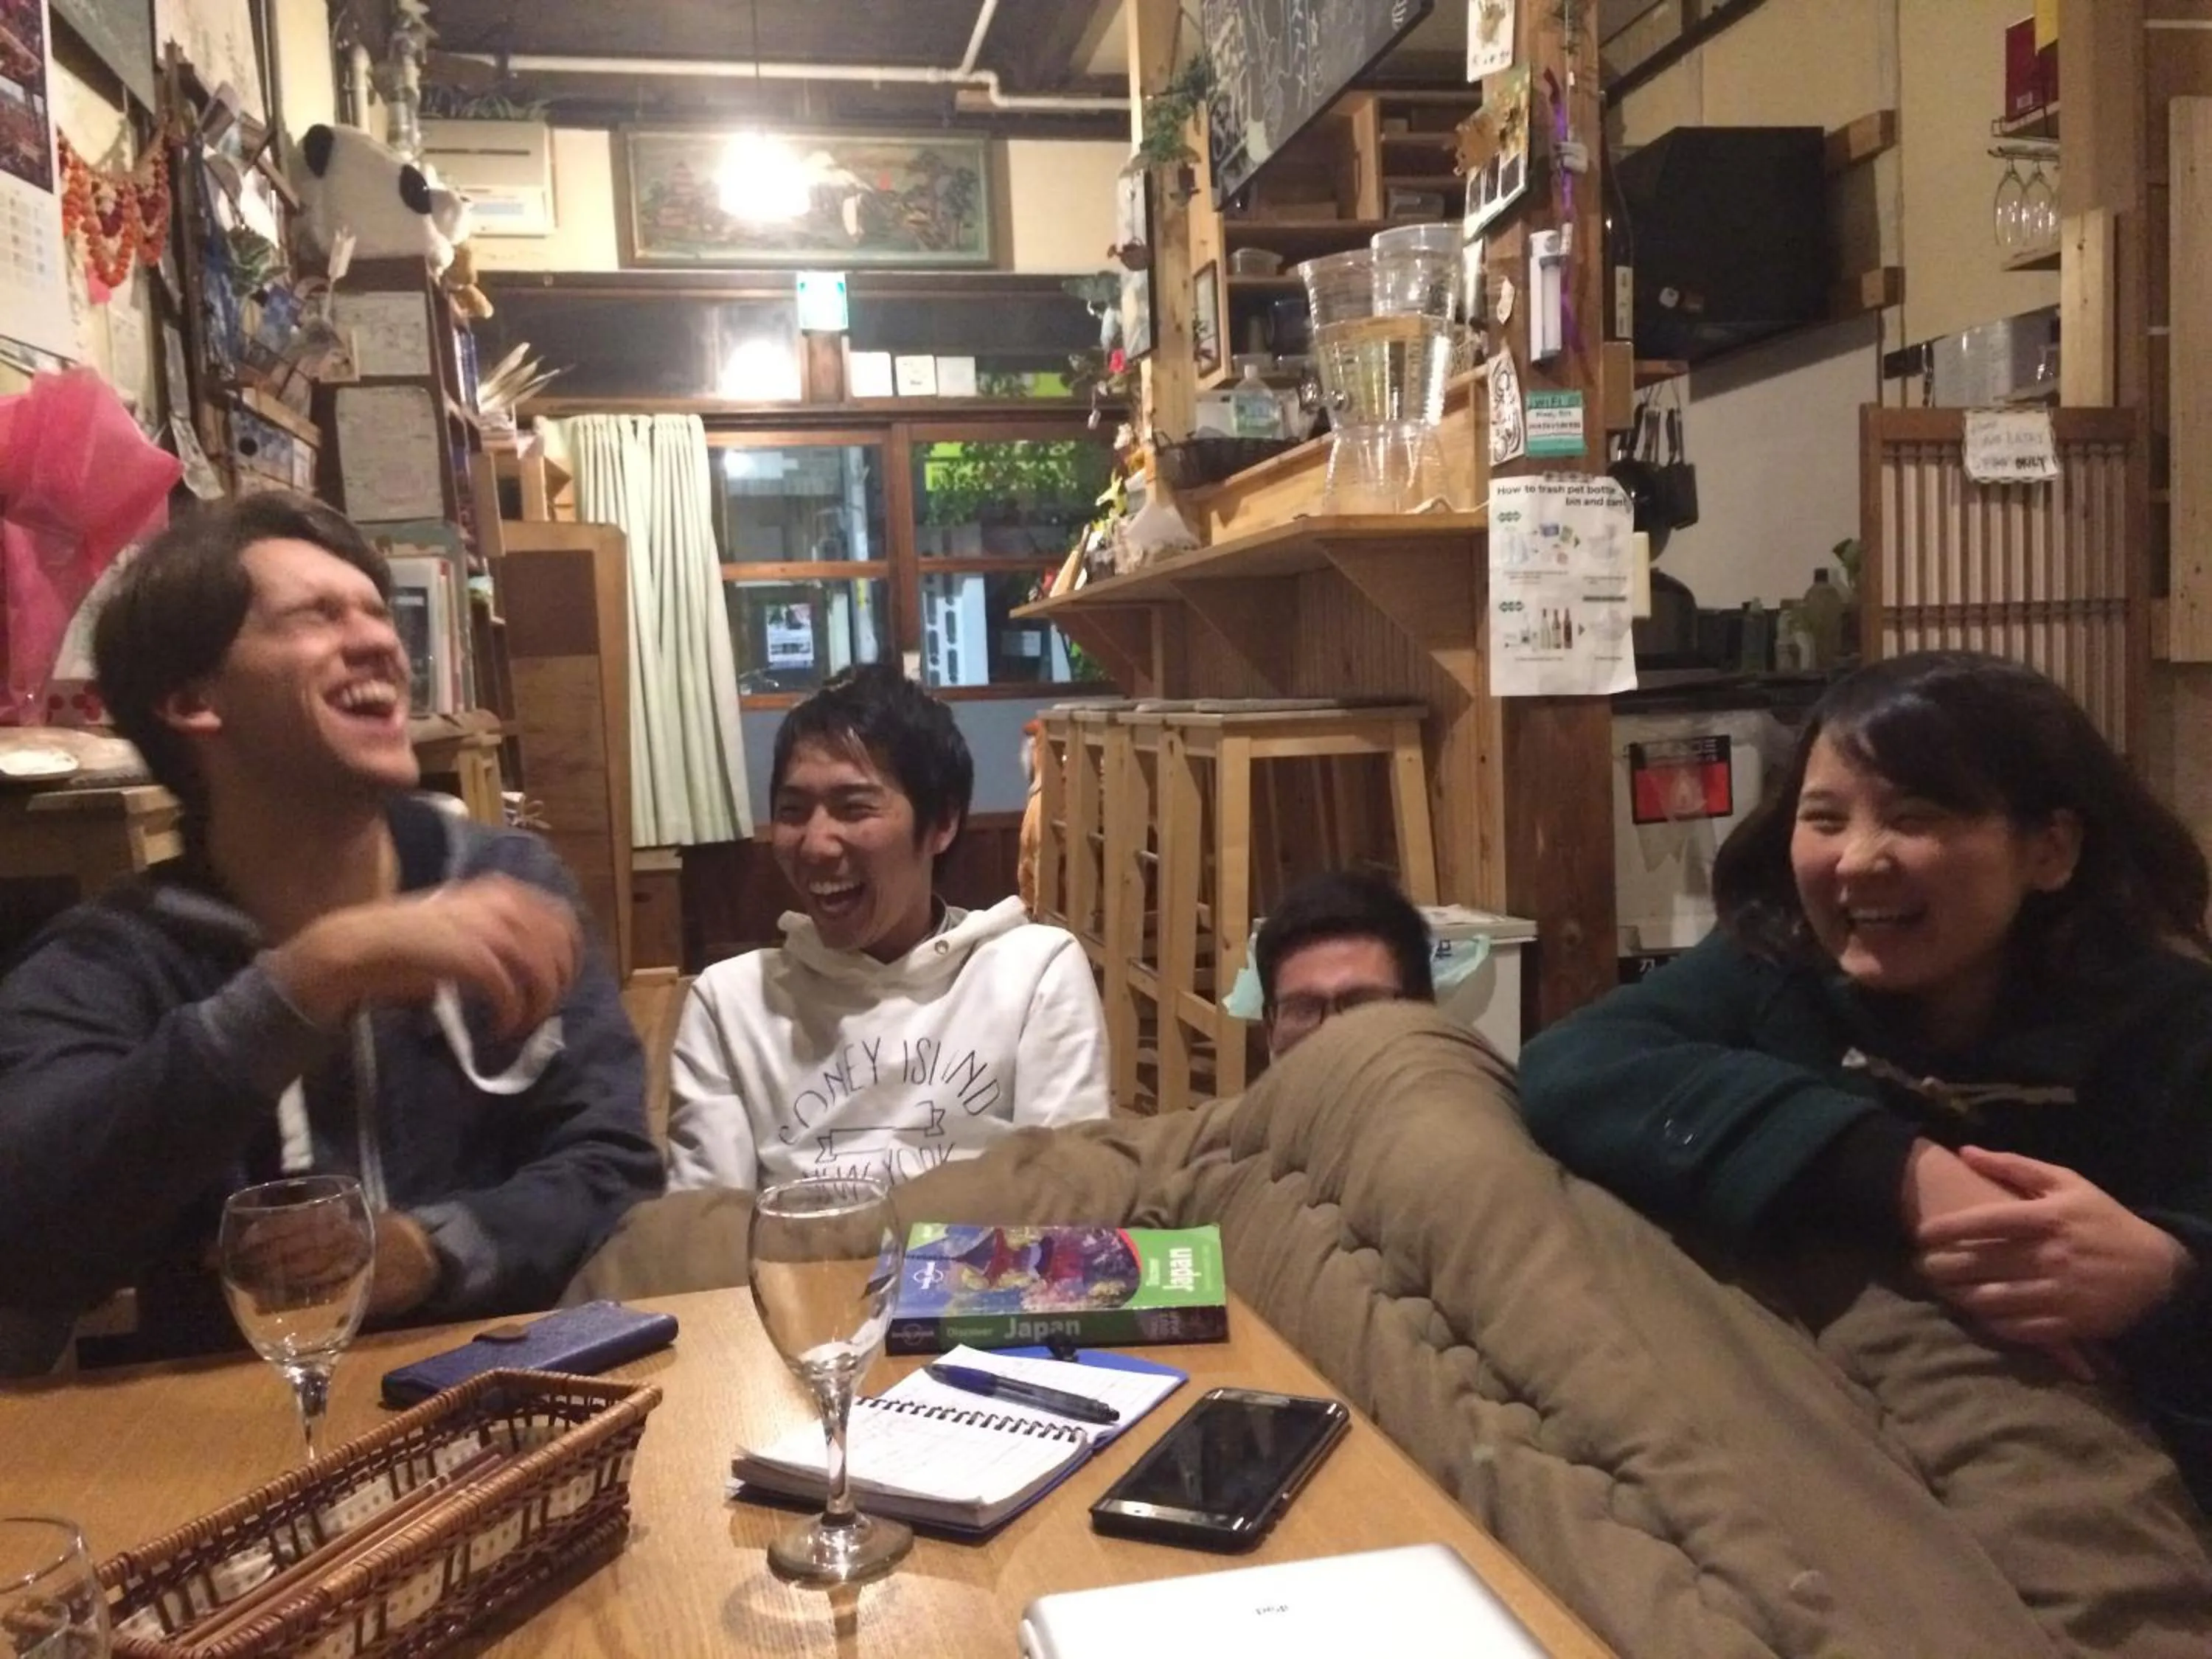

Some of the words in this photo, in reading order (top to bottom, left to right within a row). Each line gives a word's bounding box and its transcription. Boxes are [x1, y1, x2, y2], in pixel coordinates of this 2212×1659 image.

[1497, 485, 1521, 495] How
[1524, 484, 1536, 493] to
[1538, 484, 1565, 493] trash
[1567, 485, 1585, 495] pet
[1584, 496, 1604, 506] and
[779, 1036, 880, 1145] CONEY
[1162, 1247, 1203, 1292] Japan
[1004, 1317, 1082, 1343] Japan
